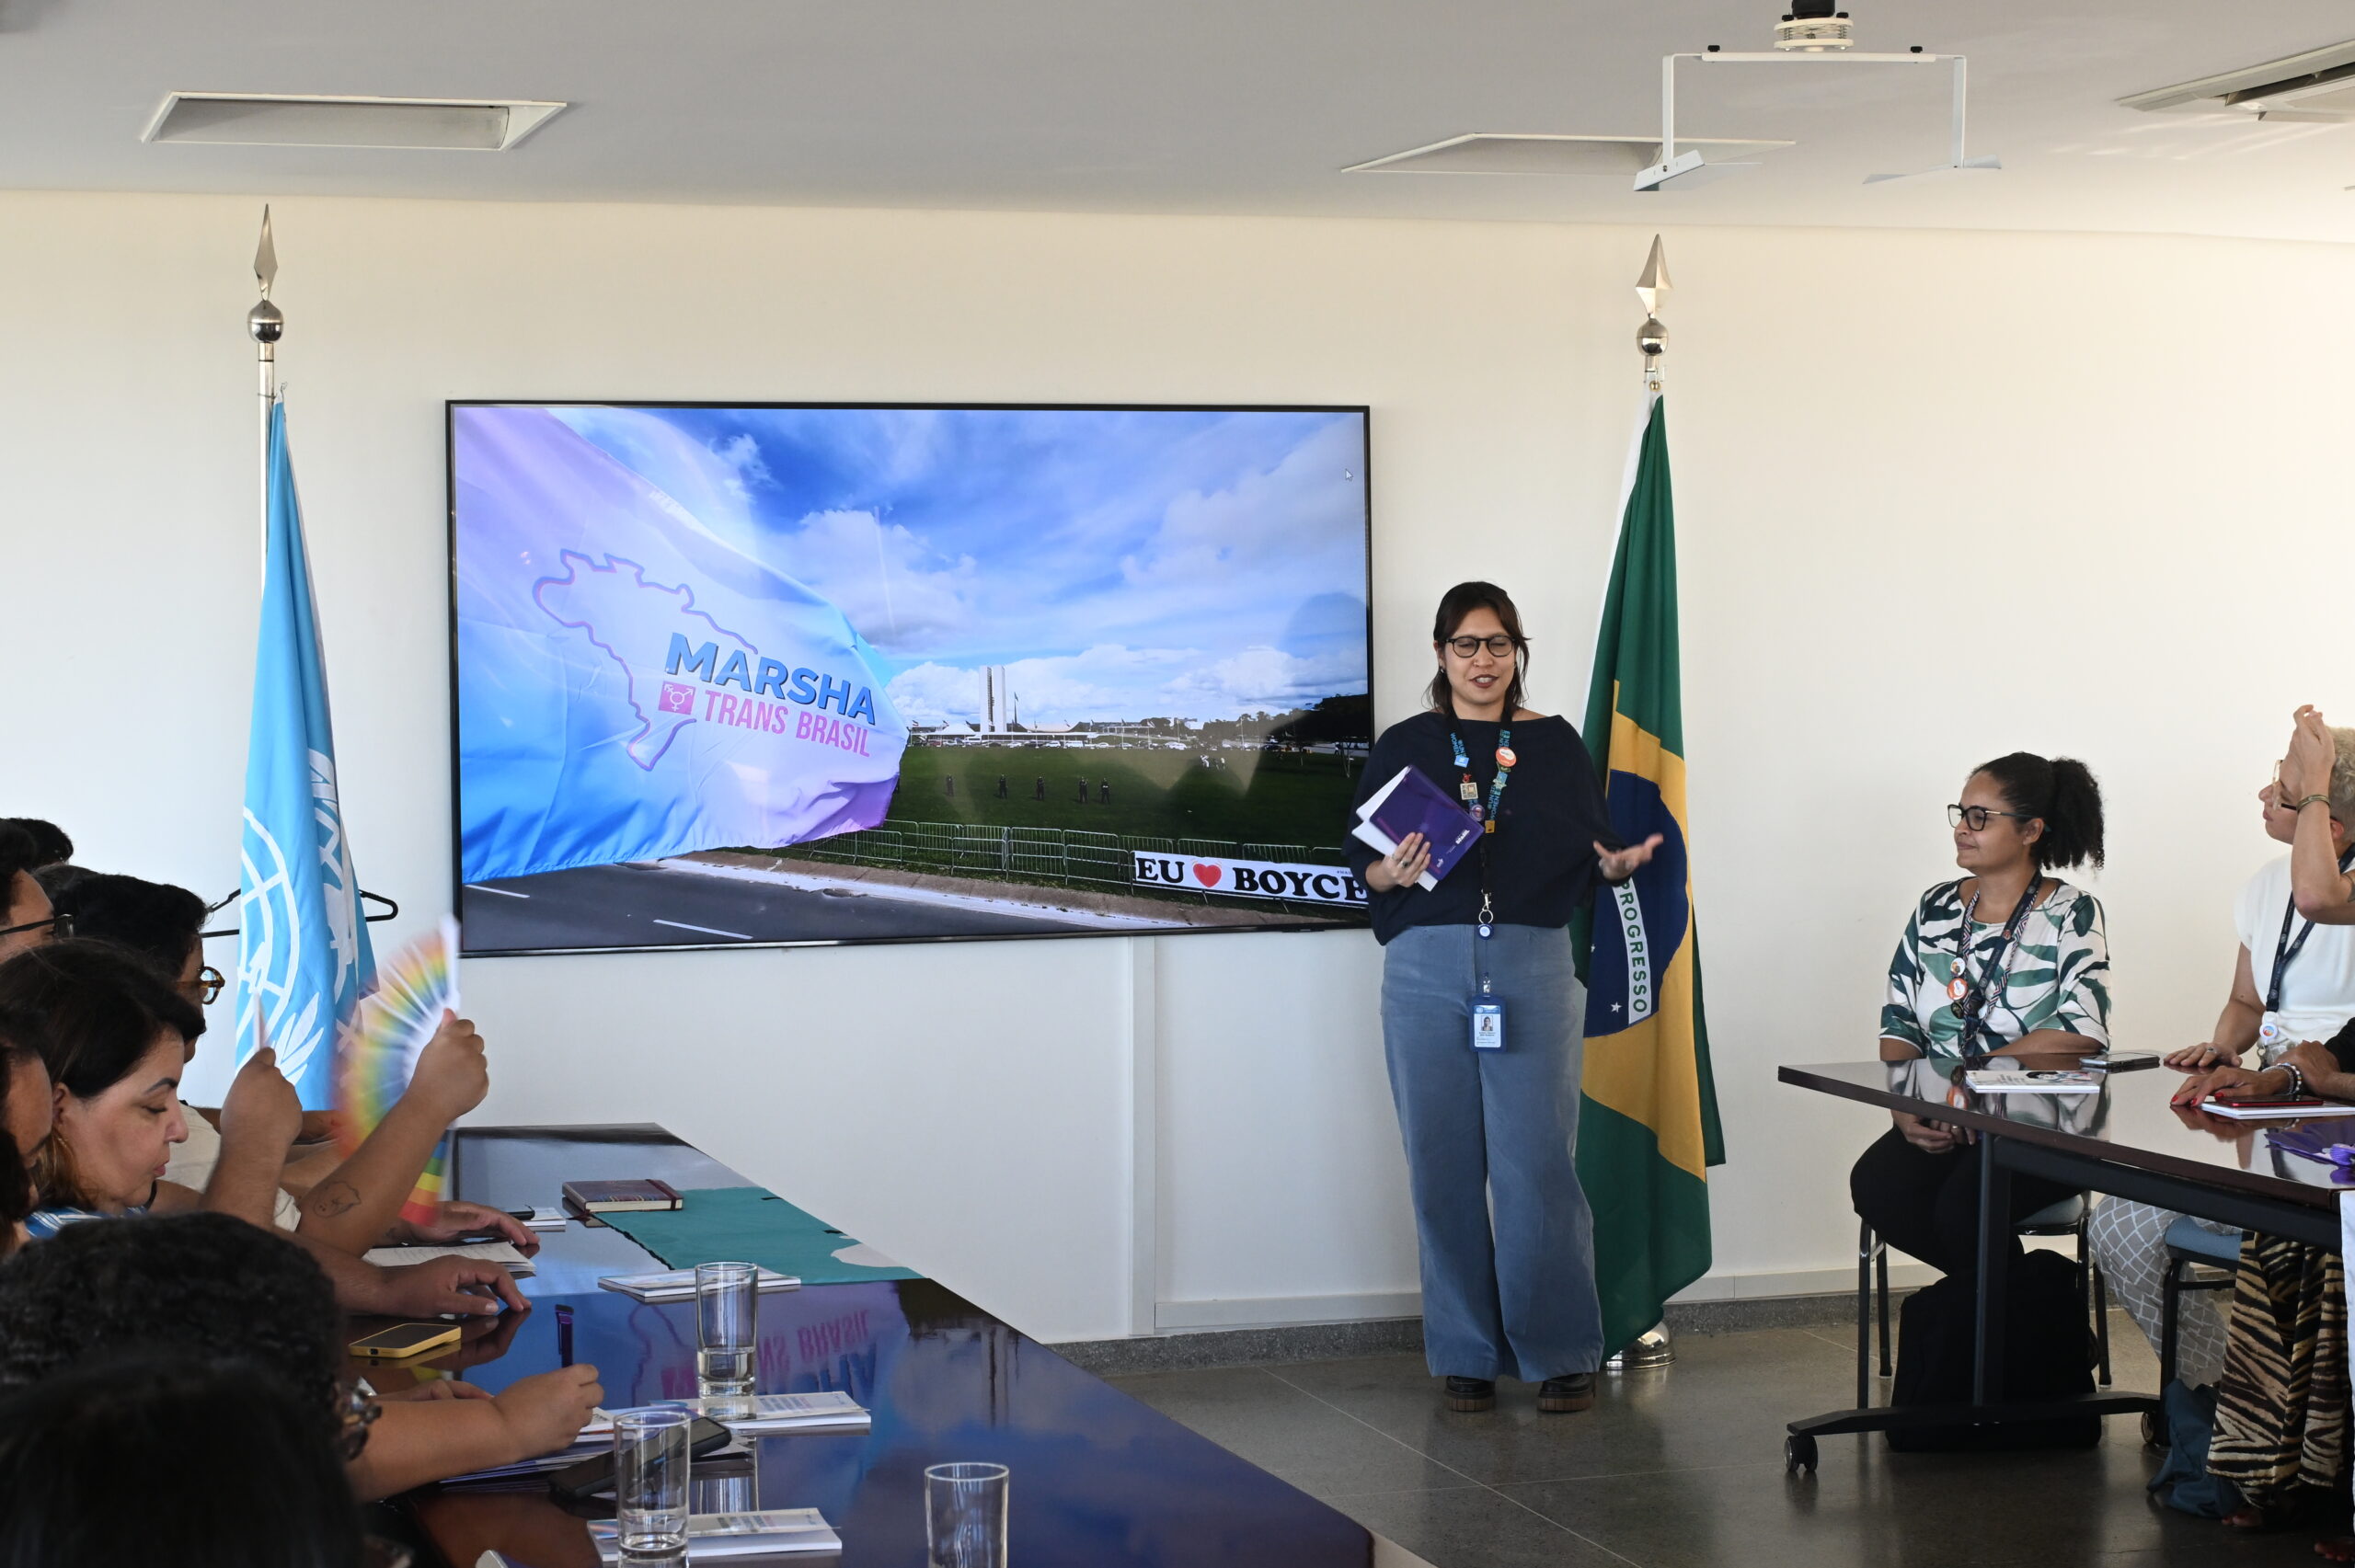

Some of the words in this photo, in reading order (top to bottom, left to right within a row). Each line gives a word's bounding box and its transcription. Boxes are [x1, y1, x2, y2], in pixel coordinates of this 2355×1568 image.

[664, 632, 876, 725] MARSHA
[705, 690, 788, 735] TRANS
[796, 711, 870, 757] BRASIL
[1135, 857, 1185, 883] EU
[1619, 881, 1648, 1013] PROGRESSO
